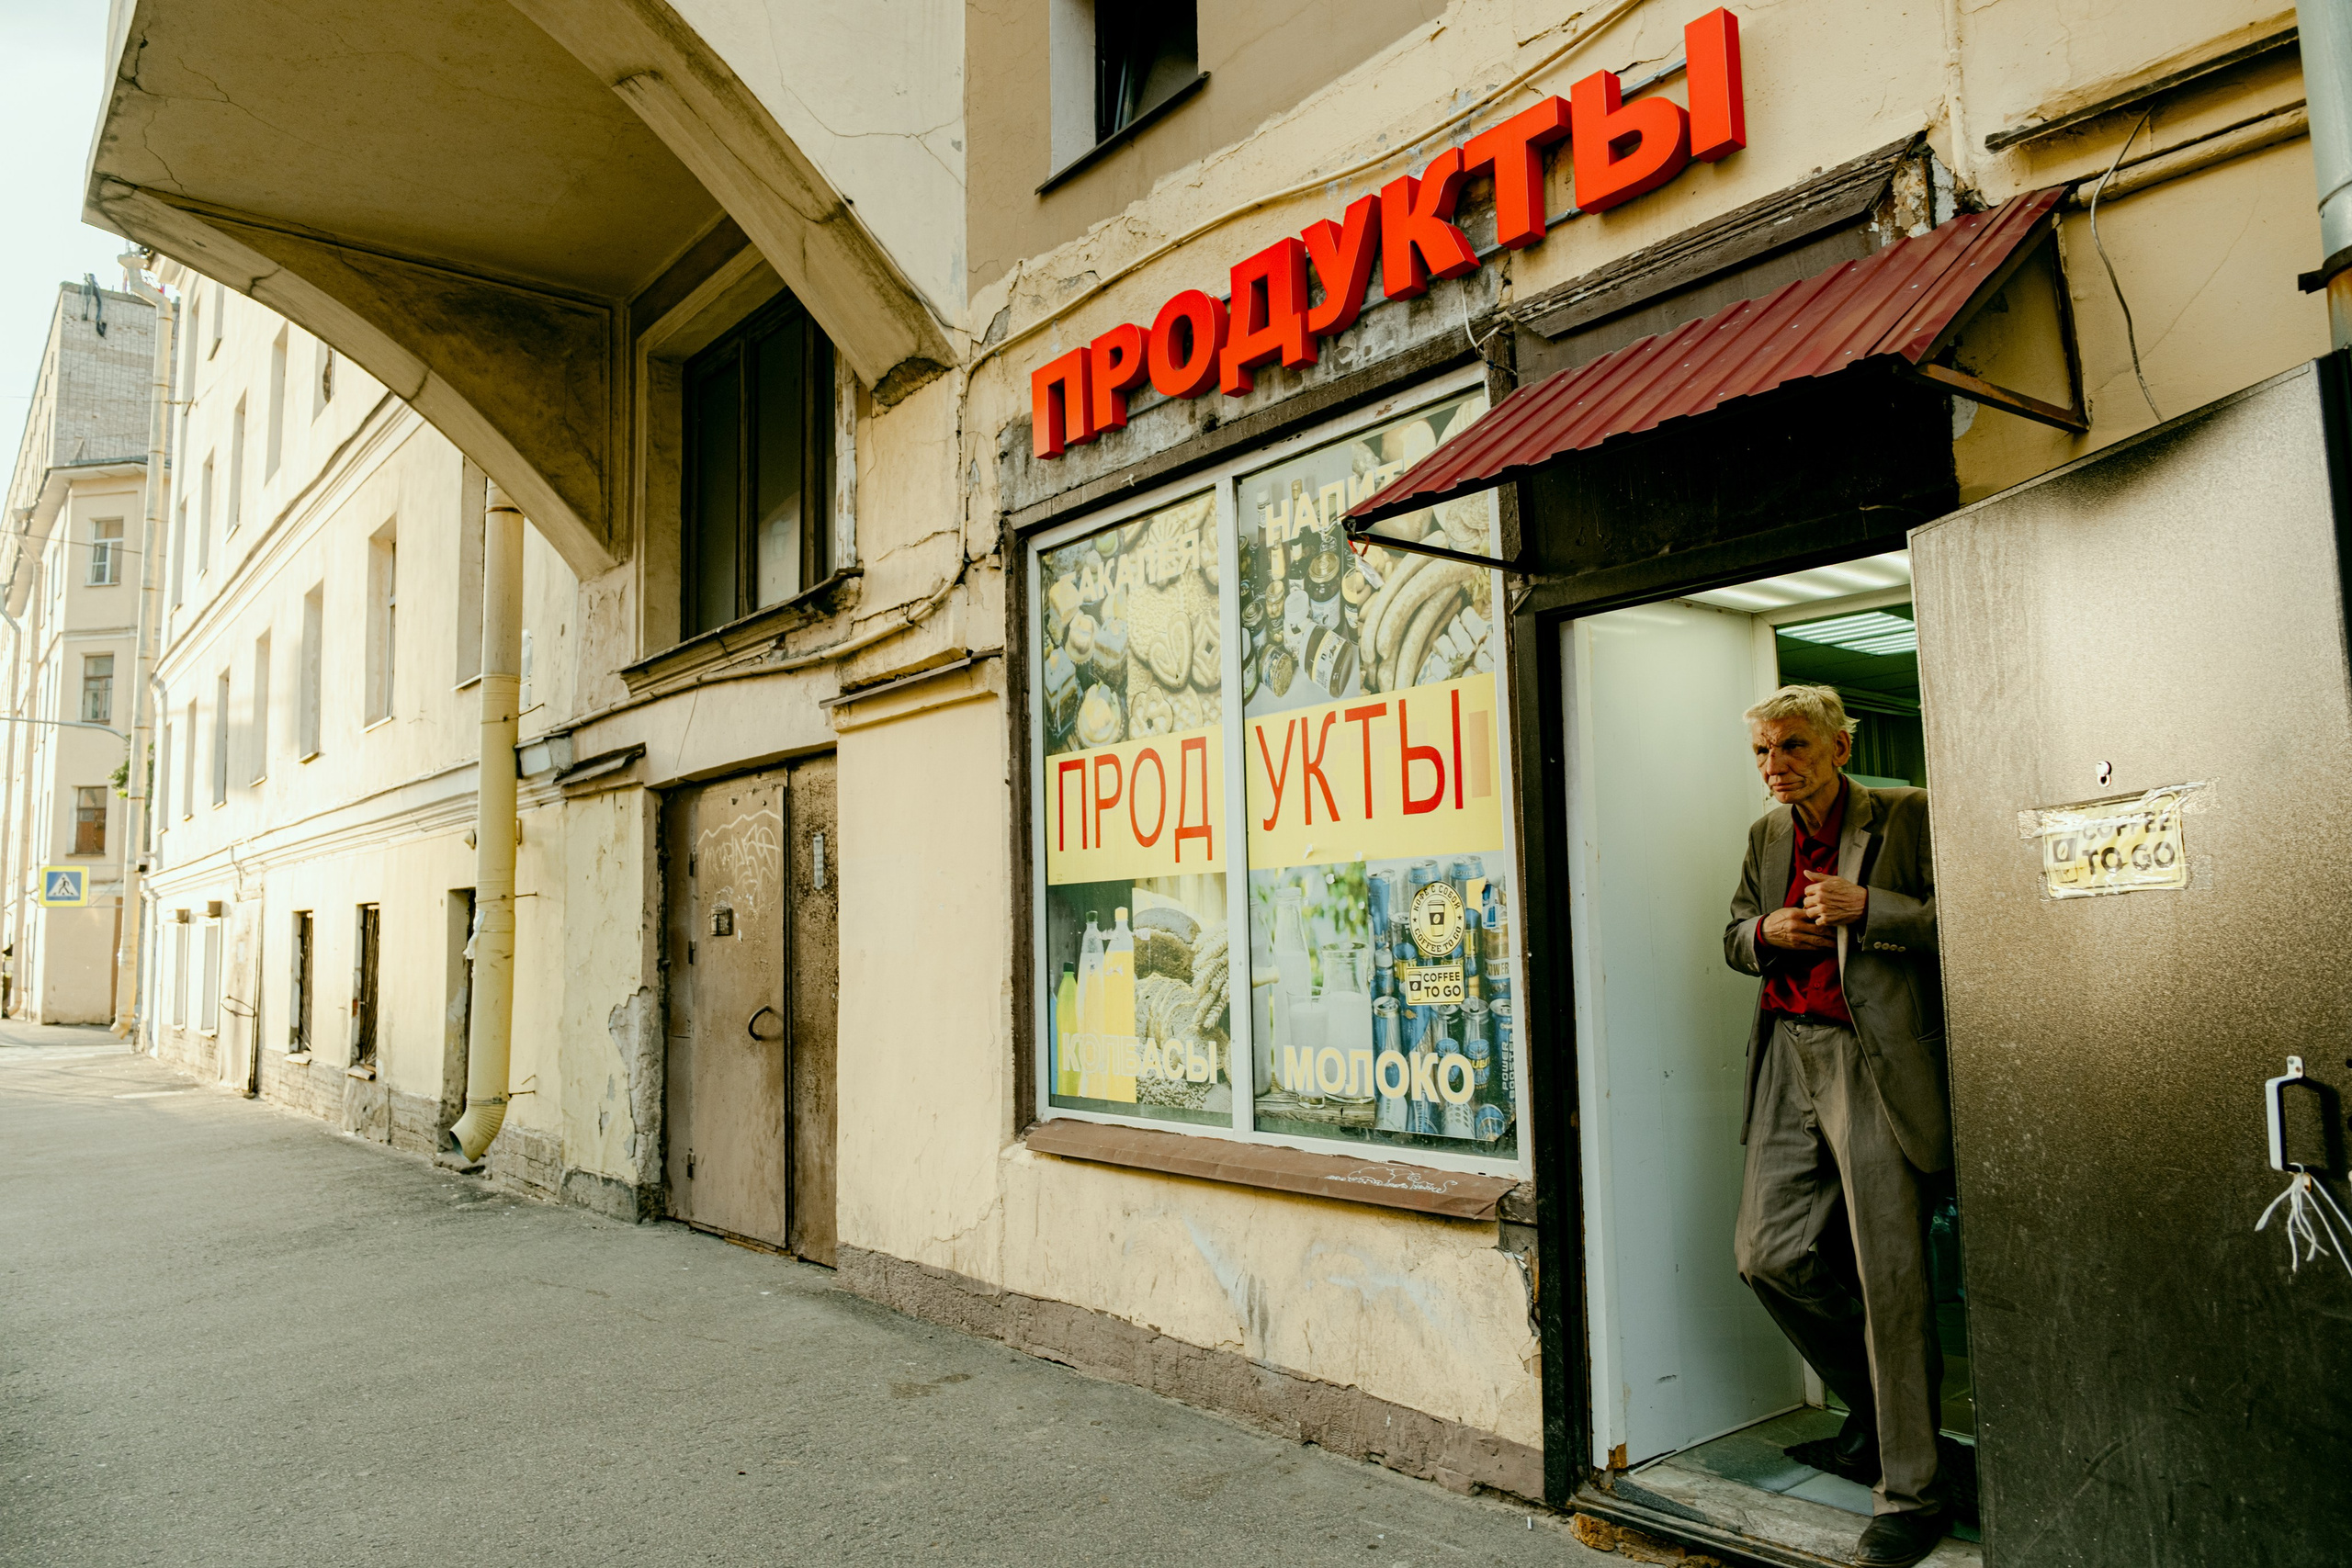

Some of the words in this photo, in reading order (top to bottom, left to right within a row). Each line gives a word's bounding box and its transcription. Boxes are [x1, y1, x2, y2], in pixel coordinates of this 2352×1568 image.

[1032, 6, 1747, 459] ПРОДУКТЫ
[1265, 457, 1418, 547] НАПИТ
[2082, 810, 2174, 840] COFFEE
[2082, 846, 2123, 875] TO
[2131, 841, 2176, 871] GO
[1413, 887, 1430, 912] КОФЕ
[1438, 885, 1462, 909] СОБОЙ
[1414, 928, 1442, 953] COFFEE
[1443, 939, 1454, 951] TO
[1453, 926, 1462, 941] GO
[1423, 971, 1461, 983] COFFEE
[1424, 986, 1441, 998] TO
[1442, 985, 1462, 997] GO
[1062, 1032, 1218, 1084] КОЛБАСЫ
[1283, 1045, 1476, 1105] МОЛОКО
